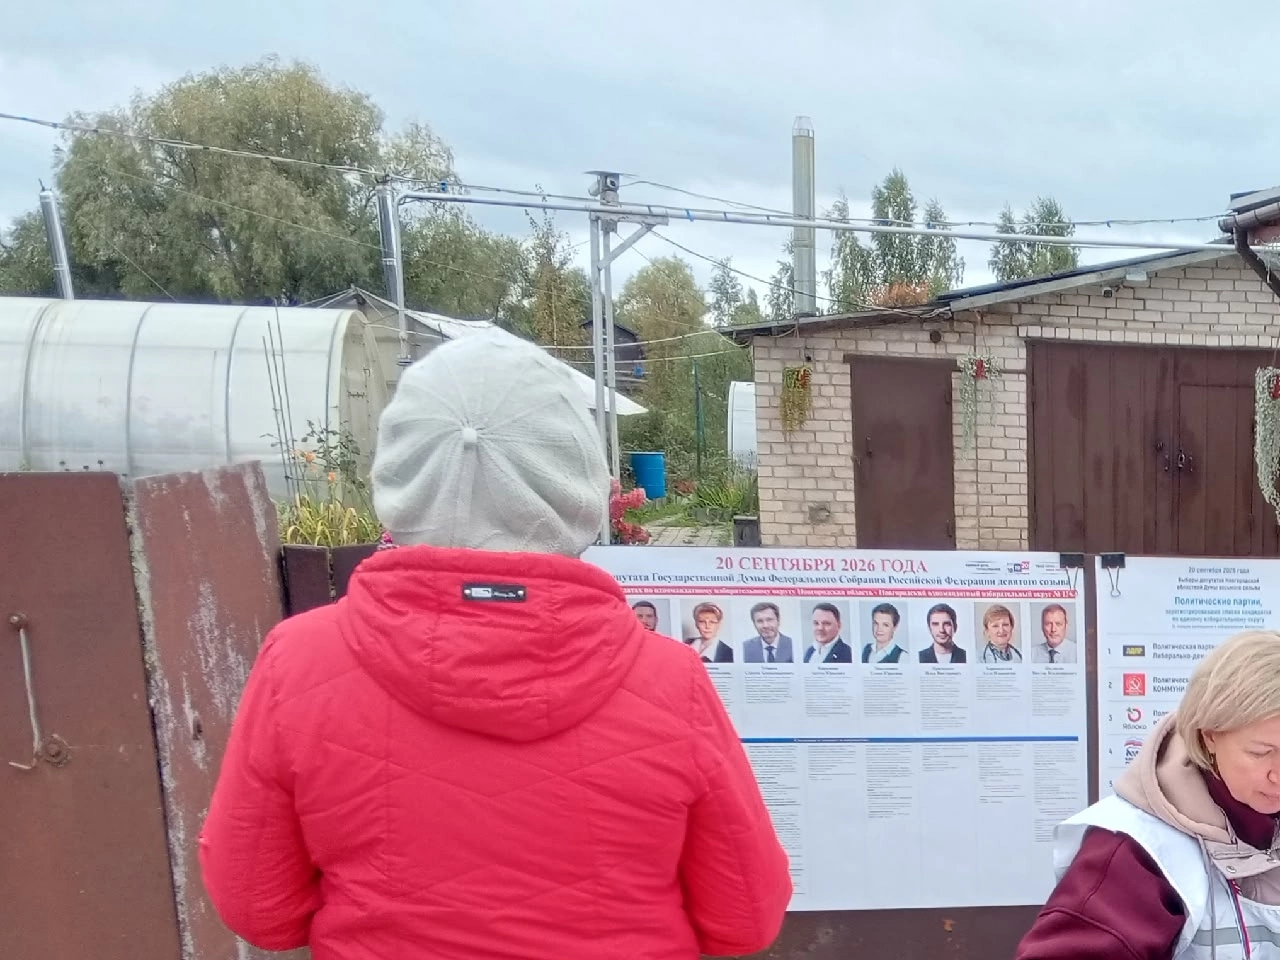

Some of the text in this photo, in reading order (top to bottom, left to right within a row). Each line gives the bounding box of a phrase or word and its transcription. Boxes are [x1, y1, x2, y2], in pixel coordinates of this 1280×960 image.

[715, 556, 928, 574] 20 СЕНТЯБРЯ 2026 ГОДА
[652, 573, 735, 584] Государственной
[738, 573, 766, 585] Думы
[768, 574, 837, 585] Федерального
[839, 575, 886, 586] Собрания
[888, 576, 942, 586] Российской
